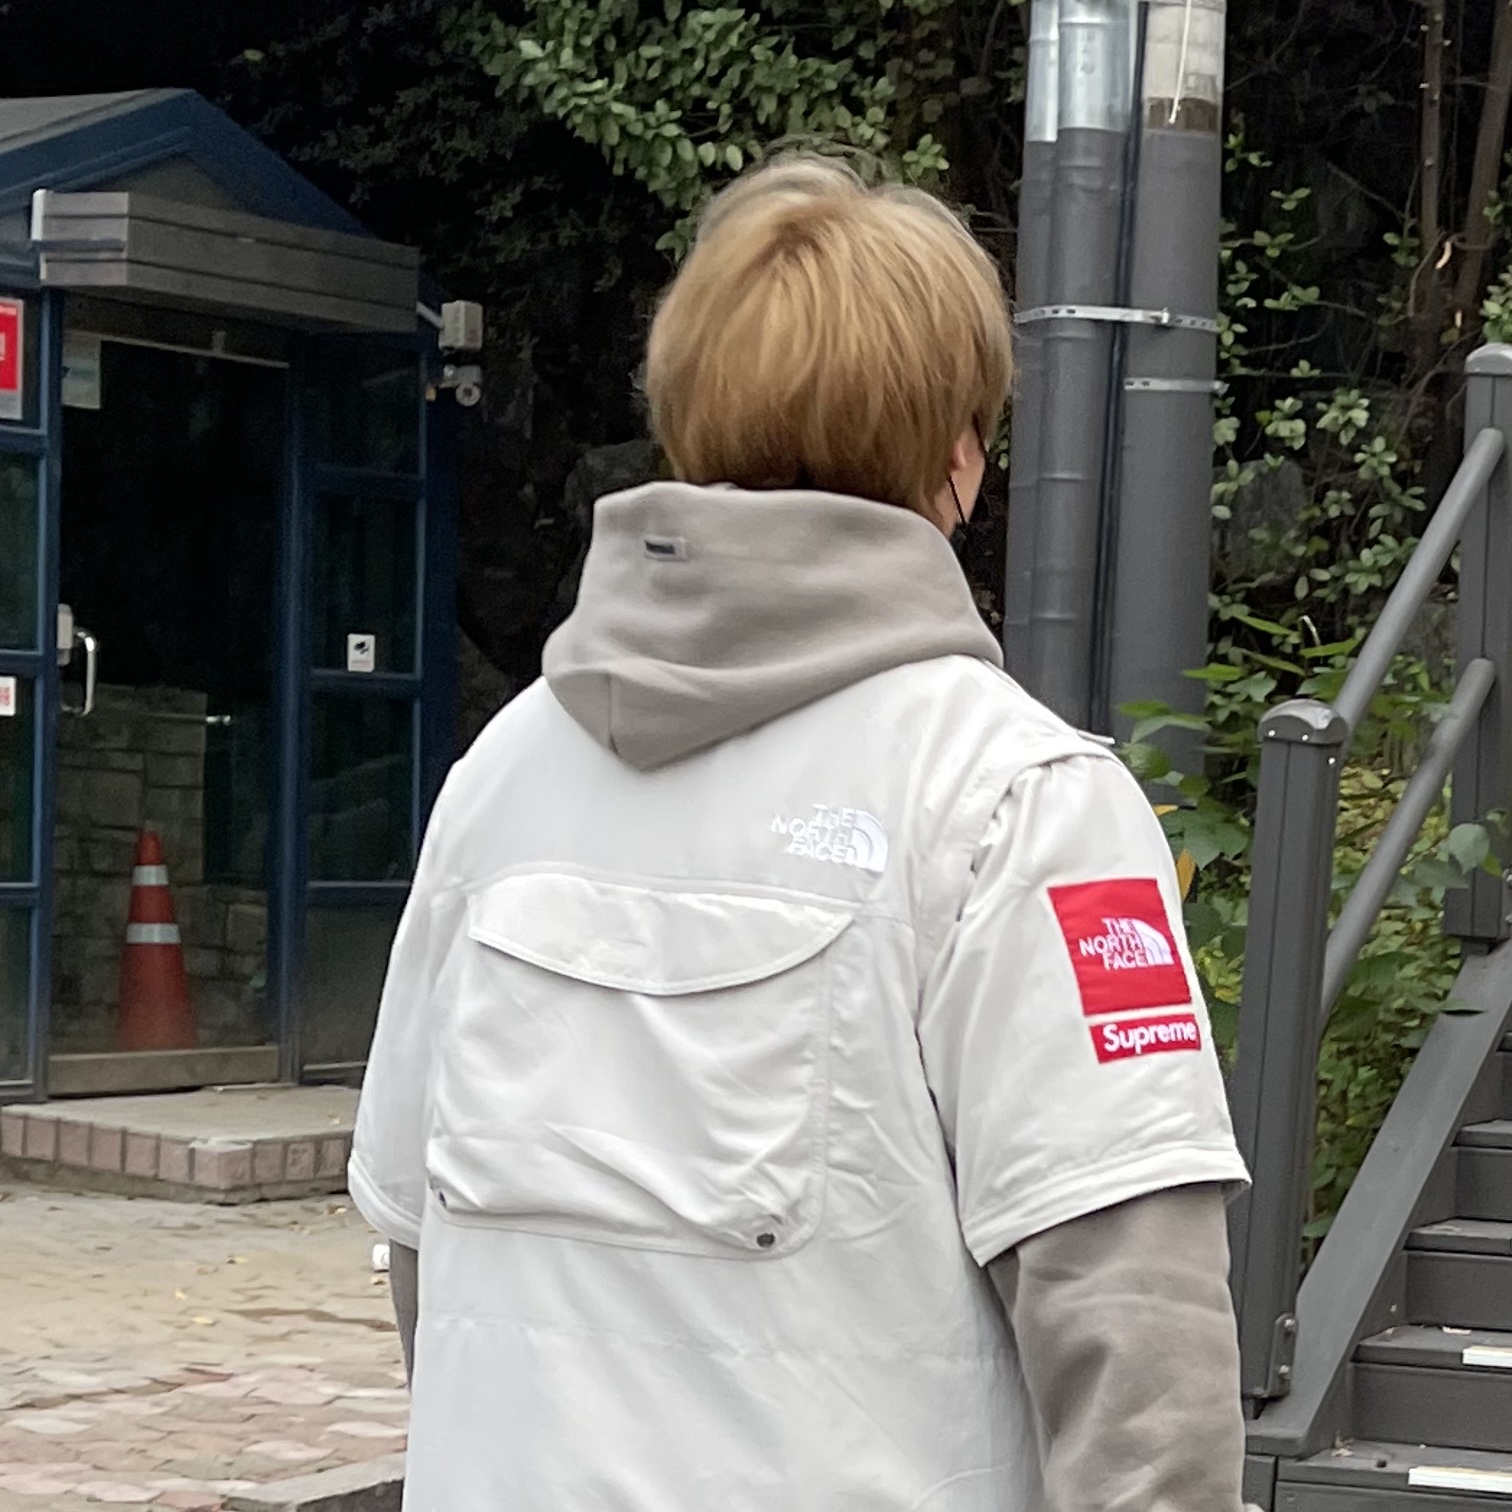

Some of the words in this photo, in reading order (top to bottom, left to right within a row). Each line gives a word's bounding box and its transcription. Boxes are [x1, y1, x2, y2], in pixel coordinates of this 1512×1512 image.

[770, 811, 854, 845] NORTH
[812, 803, 856, 828] THE
[787, 836, 846, 863] FACE
[1101, 917, 1137, 936] THE
[1079, 934, 1143, 956] NORTH
[1102, 951, 1147, 971] FACE
[1103, 1021, 1197, 1055] Supreme
